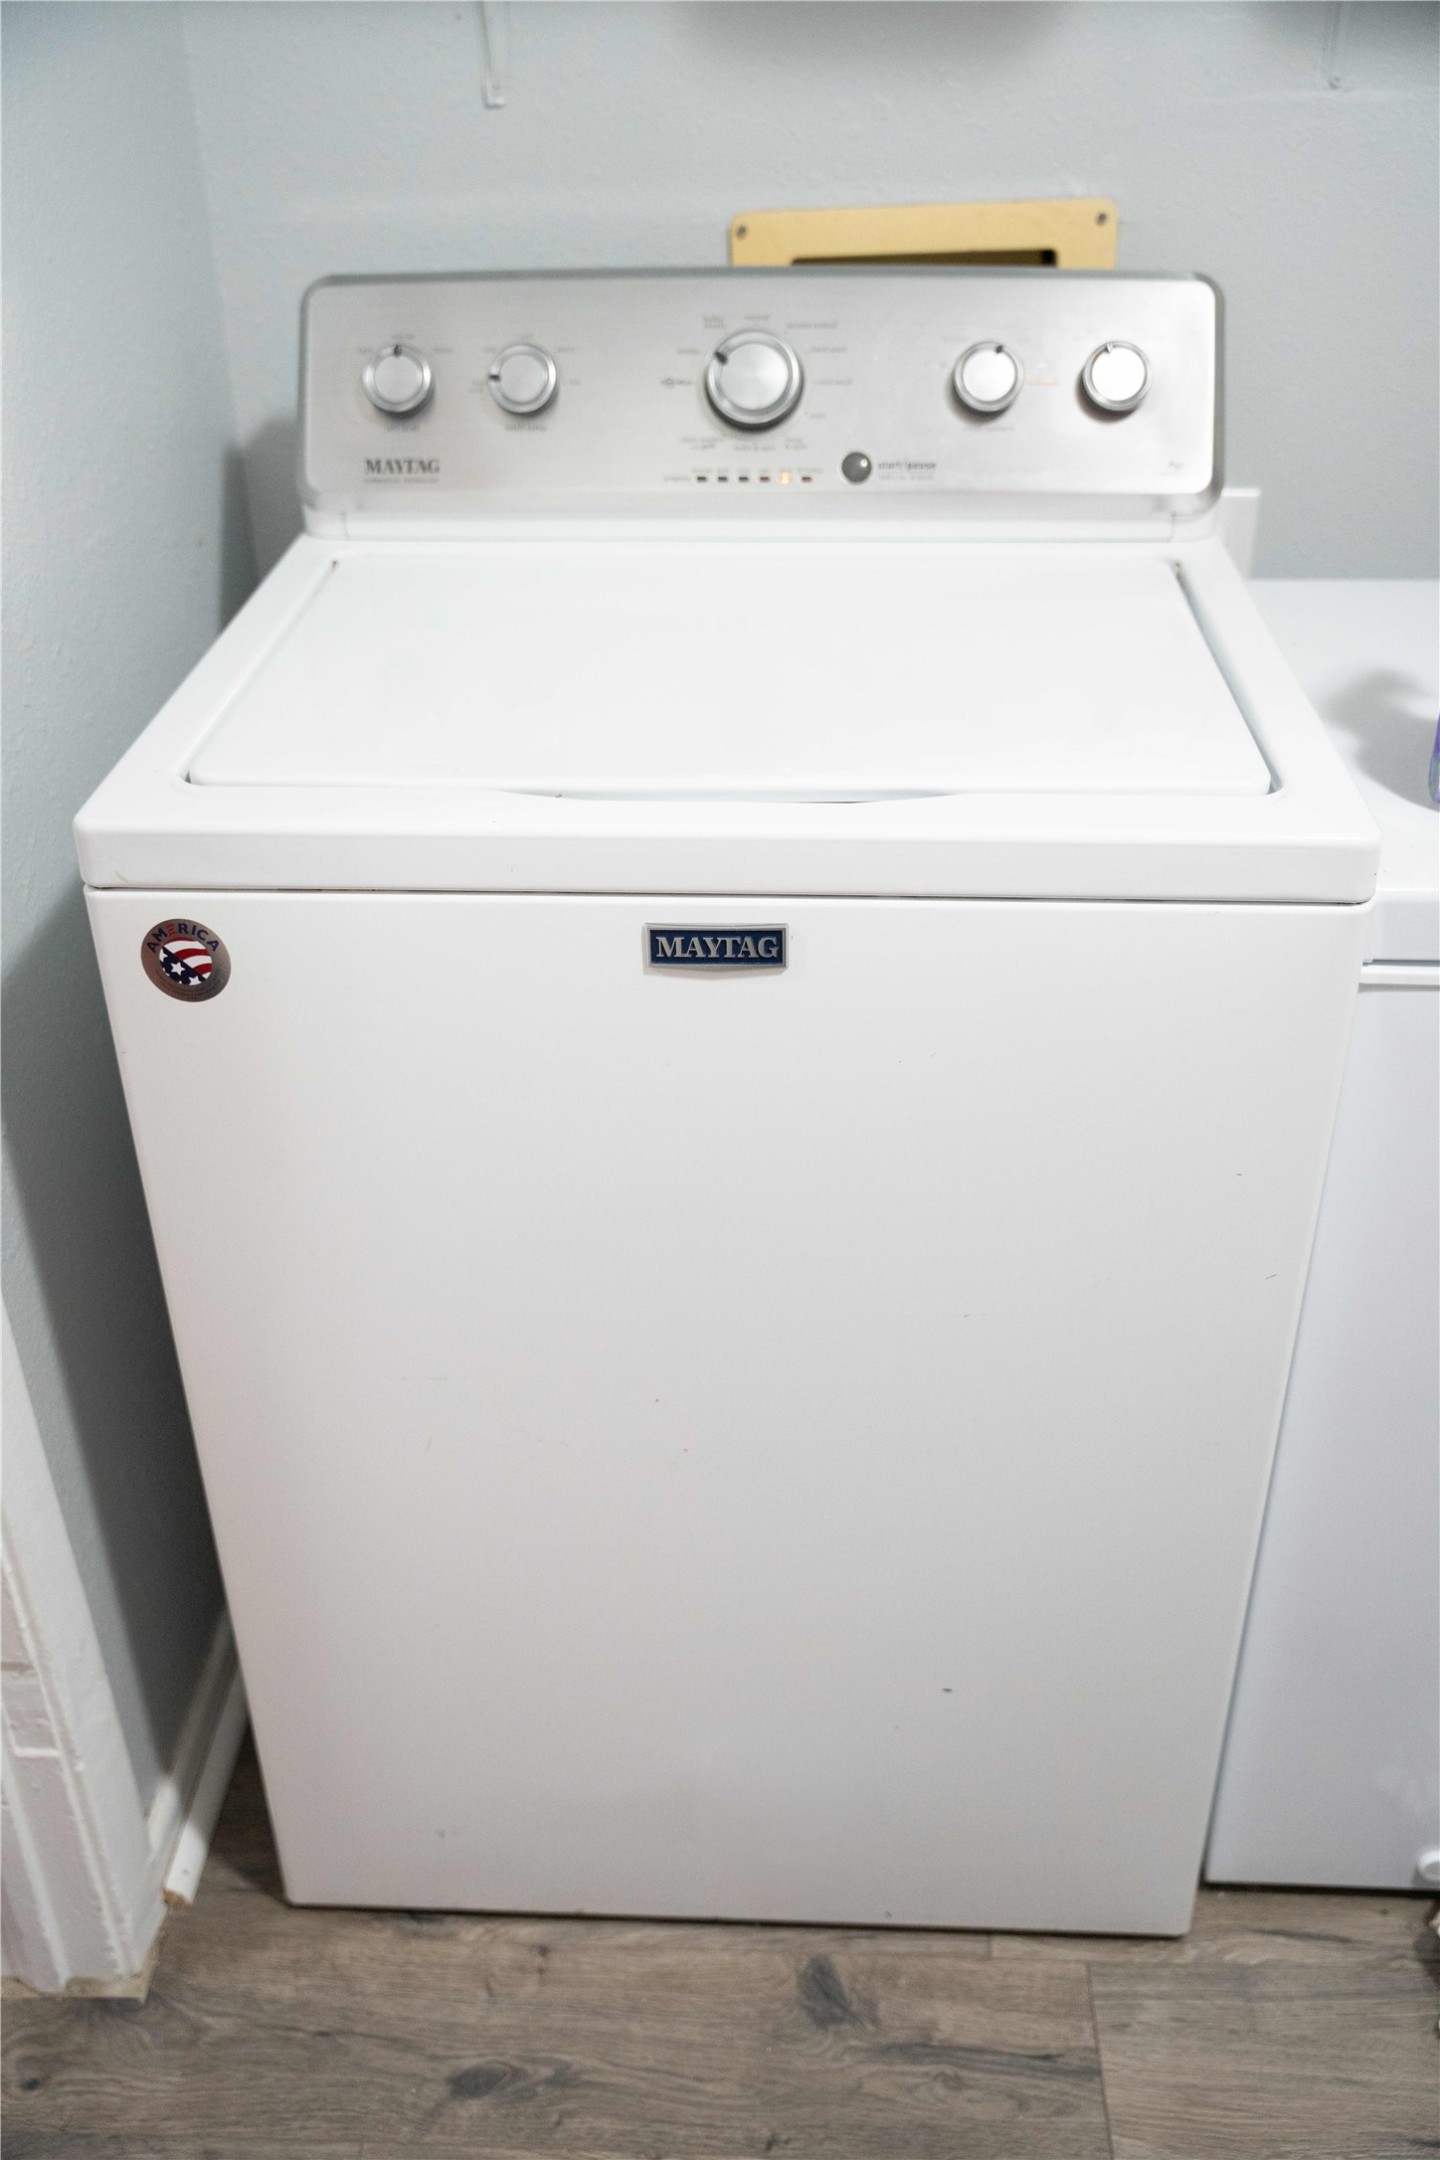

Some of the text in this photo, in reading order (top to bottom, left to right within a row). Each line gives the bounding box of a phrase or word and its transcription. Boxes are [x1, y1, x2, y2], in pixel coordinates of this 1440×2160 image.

[364, 457, 440, 474] MAYTAG
[146, 922, 219, 954] AMERICA
[655, 936, 778, 958] MAYTAG
